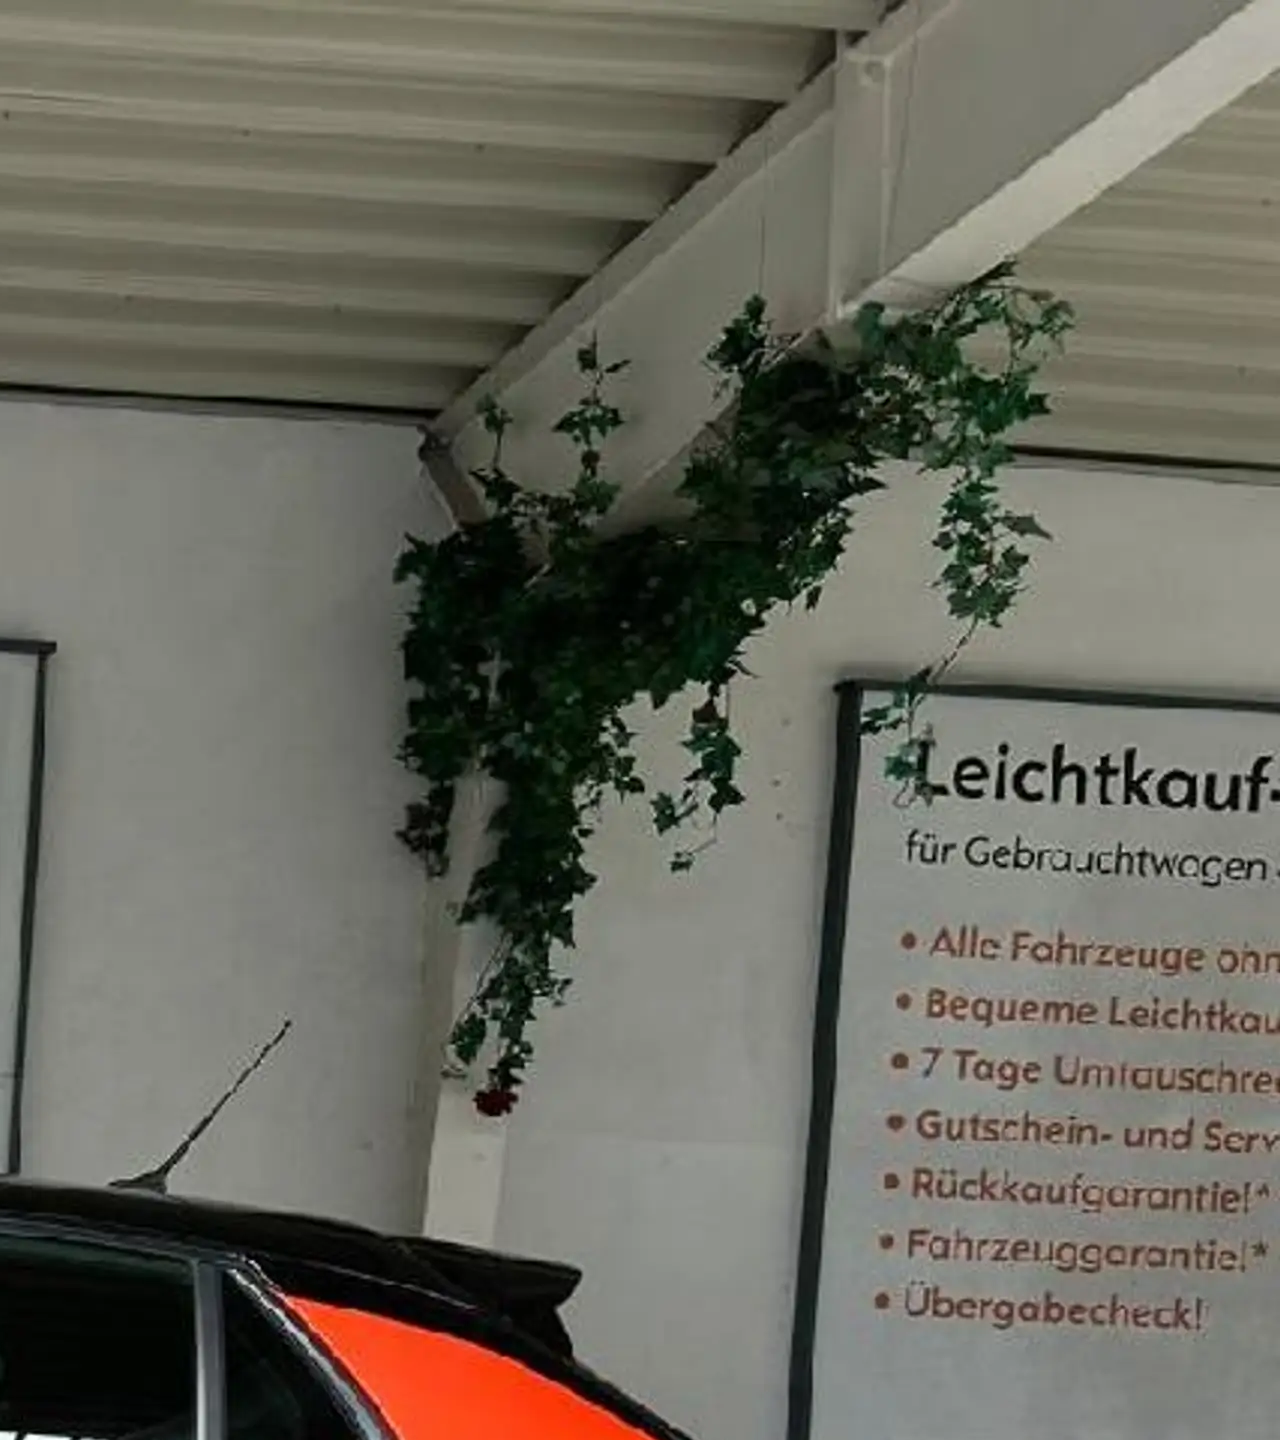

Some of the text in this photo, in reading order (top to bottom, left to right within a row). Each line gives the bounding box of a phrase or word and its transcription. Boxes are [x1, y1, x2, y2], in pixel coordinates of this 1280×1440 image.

[906, 830, 1268, 887] für Gebrauchtwagen
[929, 926, 1001, 962] Alle
[1010, 930, 1205, 975] Fahrzeuge
[925, 989, 1098, 1028] Bequeme
[921, 1048, 1280, 1095] 7 Tage Umtauschre
[916, 1109, 1113, 1147] Gutschein-
[1124, 1117, 1196, 1151] und
[903, 1281, 1204, 1331] Übergabecheck!
